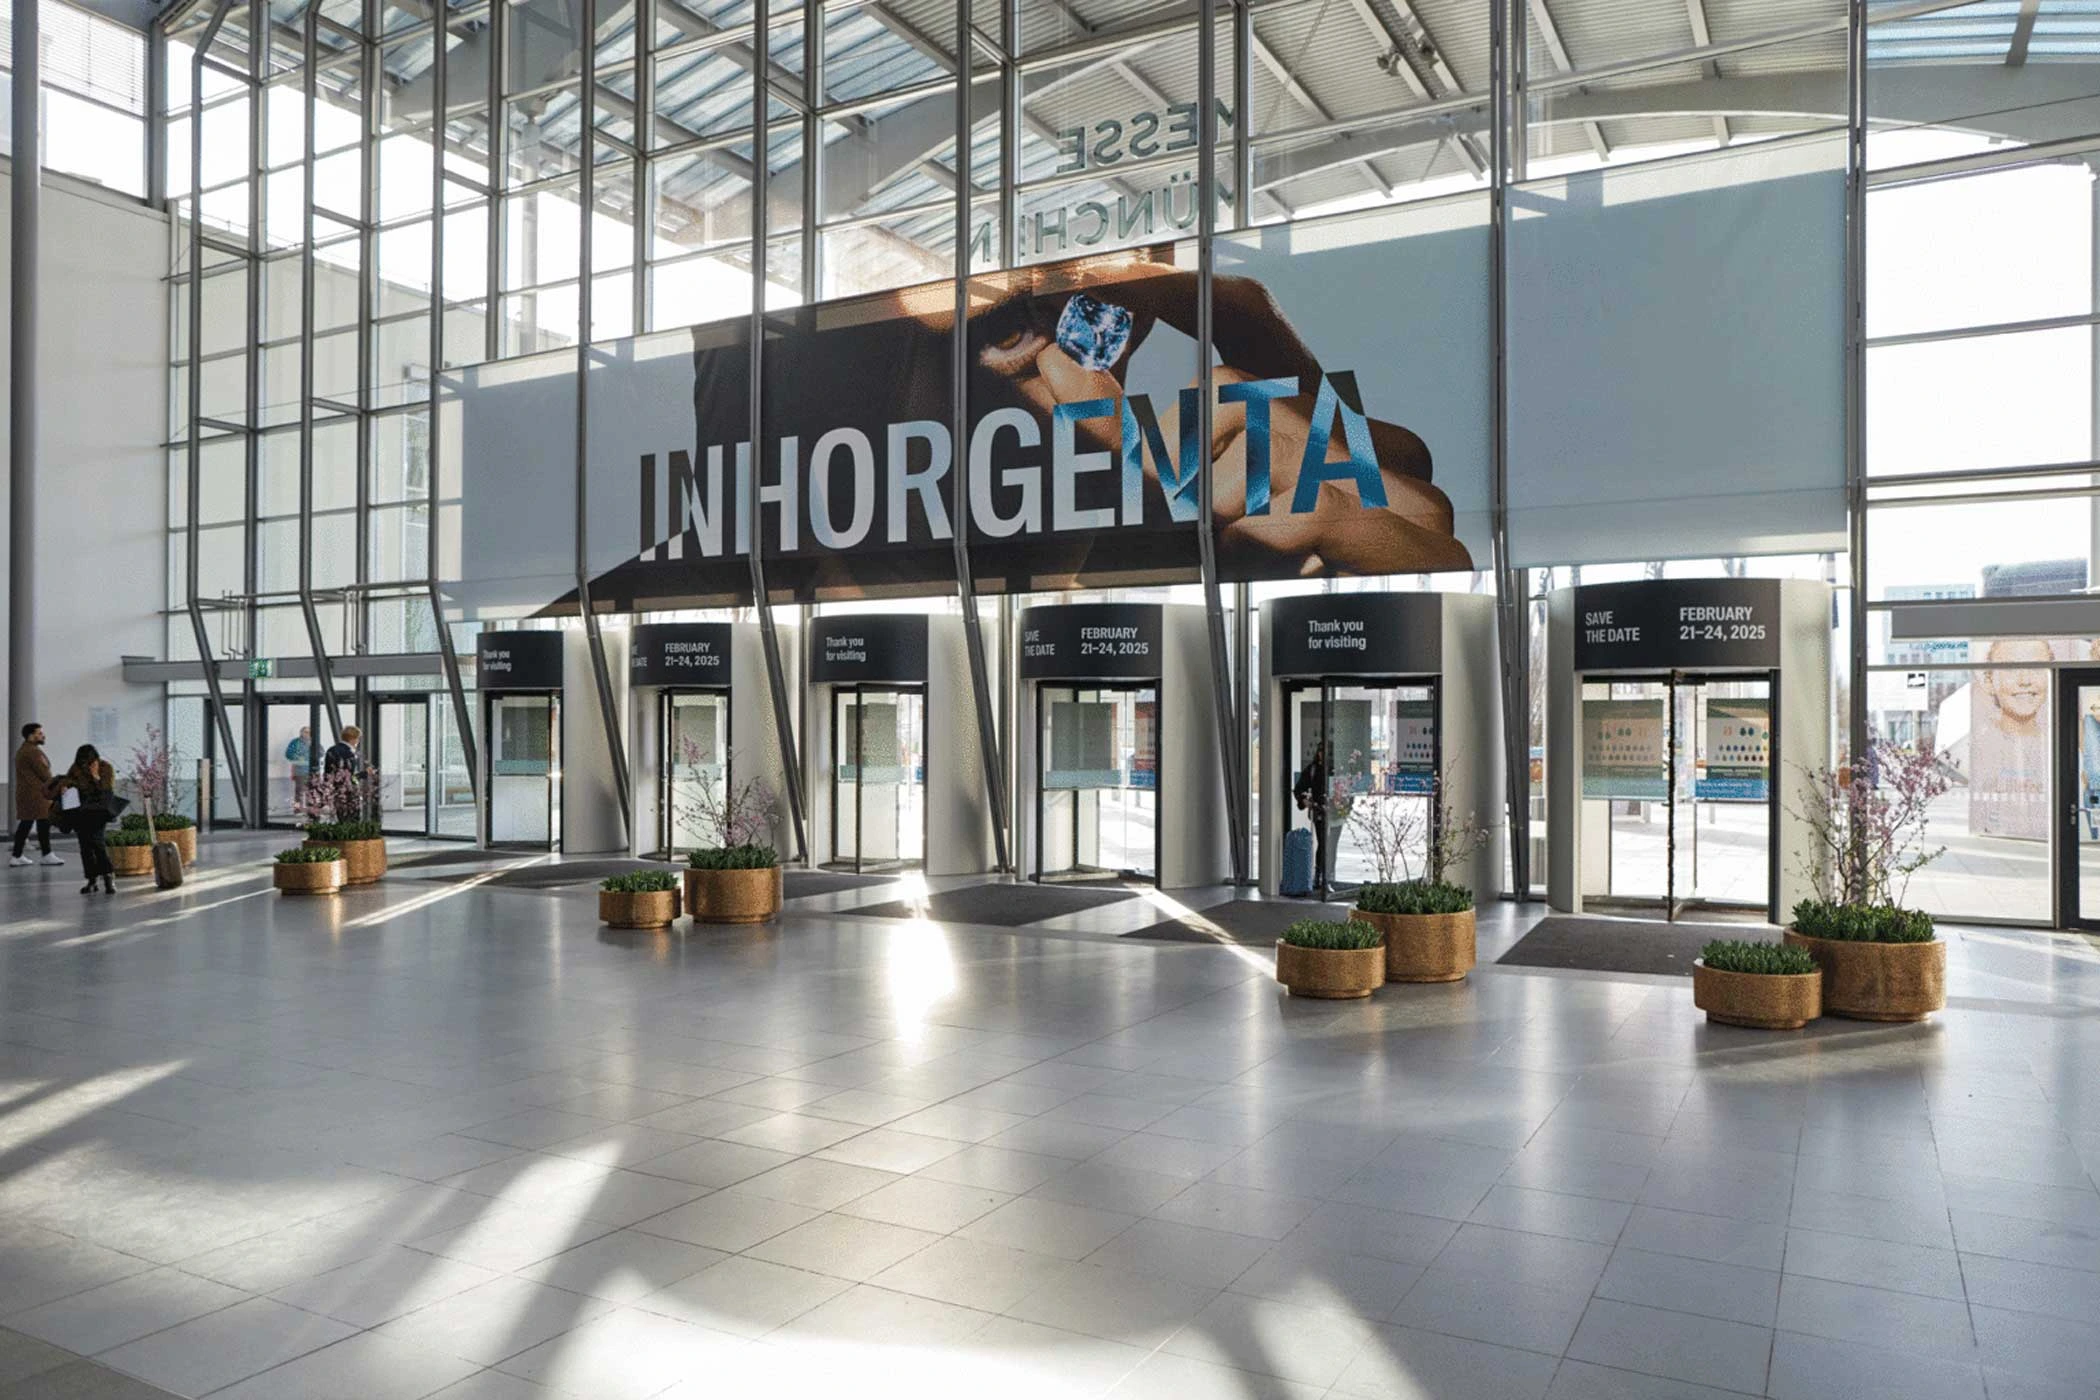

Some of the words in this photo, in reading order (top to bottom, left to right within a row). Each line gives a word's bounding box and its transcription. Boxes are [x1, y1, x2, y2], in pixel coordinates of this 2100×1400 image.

[640, 370, 1389, 562] INHORGENTA
[1585, 611, 1613, 626] SAVE
[1680, 606, 1753, 621] FEBRUARY
[1081, 627, 1138, 639] FEBRUARY
[1308, 619, 1340, 633] Thank
[1342, 621, 1364, 634] you
[1730, 625, 1766, 640] 2025
[825, 636, 848, 648] Thank
[848, 638, 864, 649] you
[1308, 636, 1322, 649] for
[1324, 635, 1366, 650] visiting
[1585, 629, 1606, 644] THE
[1608, 627, 1640, 642] DATE
[664, 642, 711, 653] FEBRUARY
[1036, 643, 1056, 656] DATE
[1118, 642, 1149, 655] 2025
[694, 655, 720, 666] 2025
[836, 650, 866, 662] visiting
